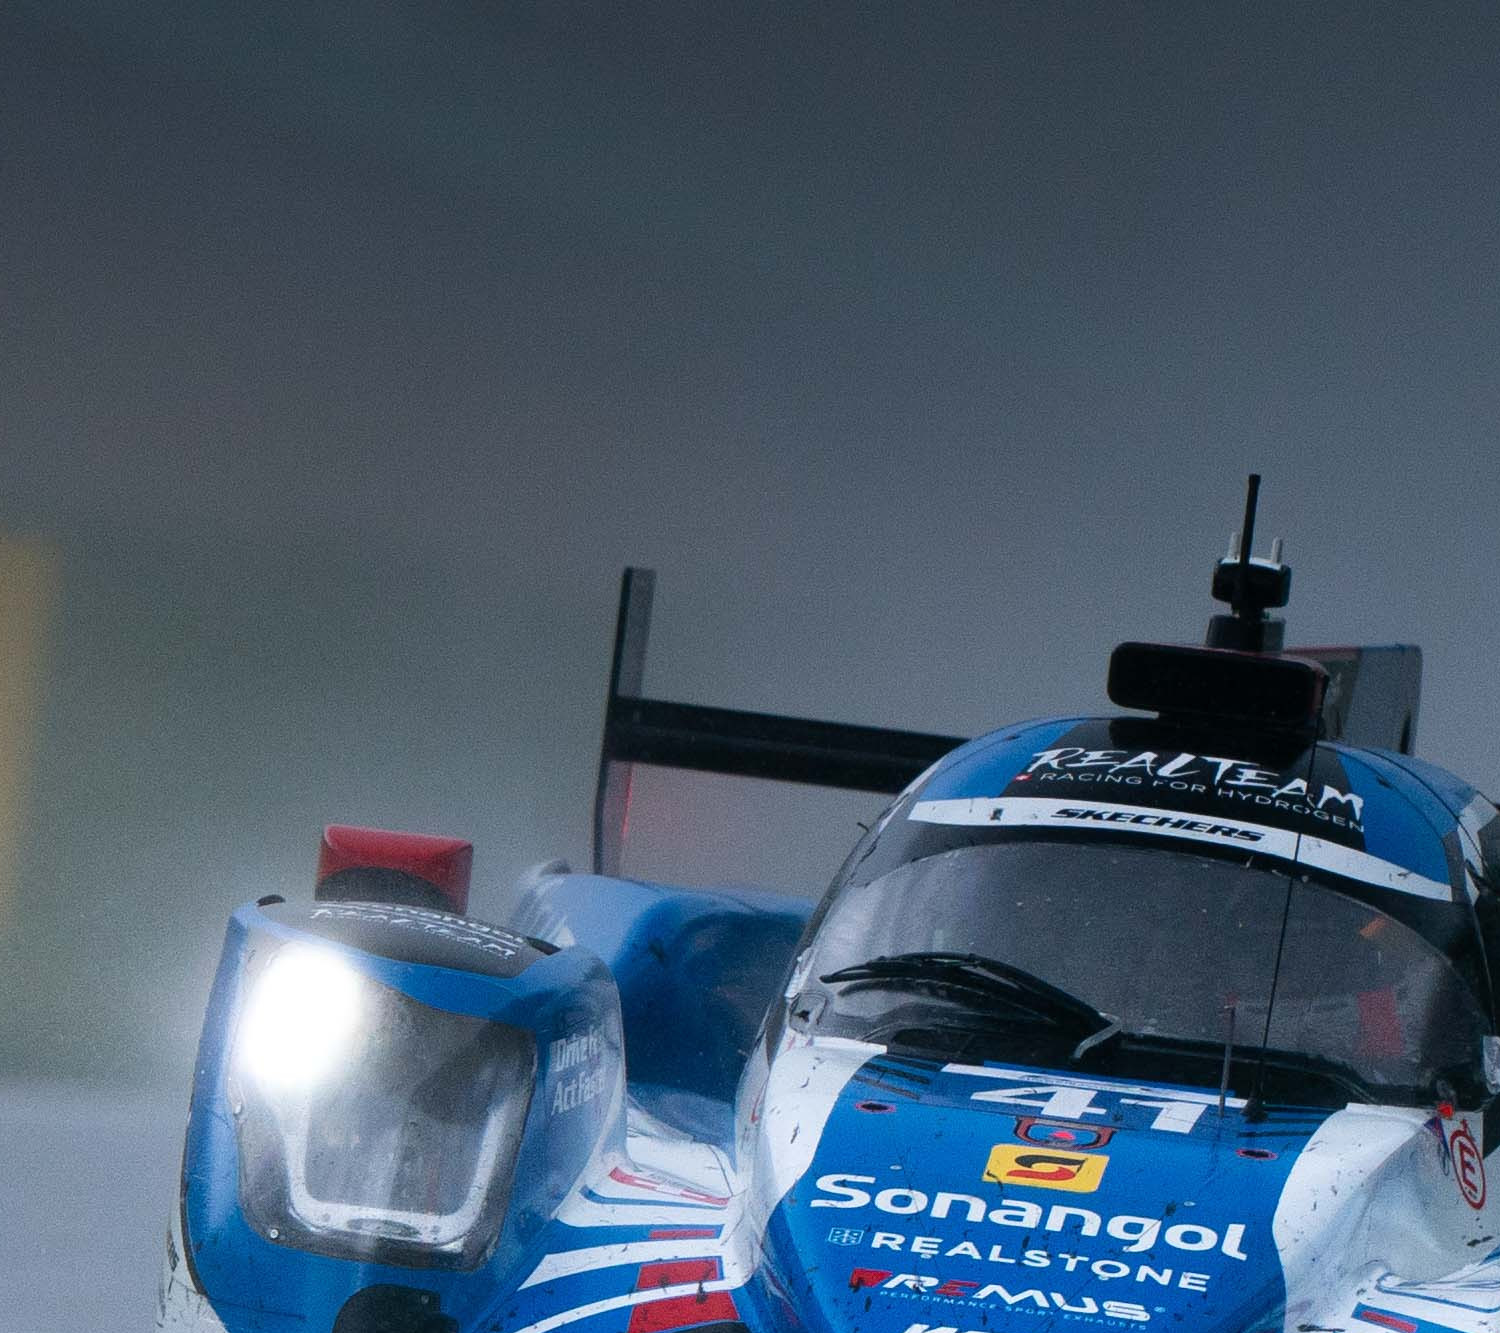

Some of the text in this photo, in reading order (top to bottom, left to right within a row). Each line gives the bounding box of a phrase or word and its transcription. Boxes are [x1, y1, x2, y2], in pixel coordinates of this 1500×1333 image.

[1026, 746, 1365, 821] REALTEAM
[1040, 771, 1364, 833] RACING FOR HYDROGEN
[1051, 807, 1267, 843] SKECHERS
[971, 1085, 1207, 1134] 41
[810, 1174, 1248, 1261] Sonangol
[870, 1231, 1211, 1292] REALSTONE
[879, 1290, 1148, 1331] PERFORMANCE SPORT EXHAUSTS
[883, 1272, 1151, 1322] REMUS
